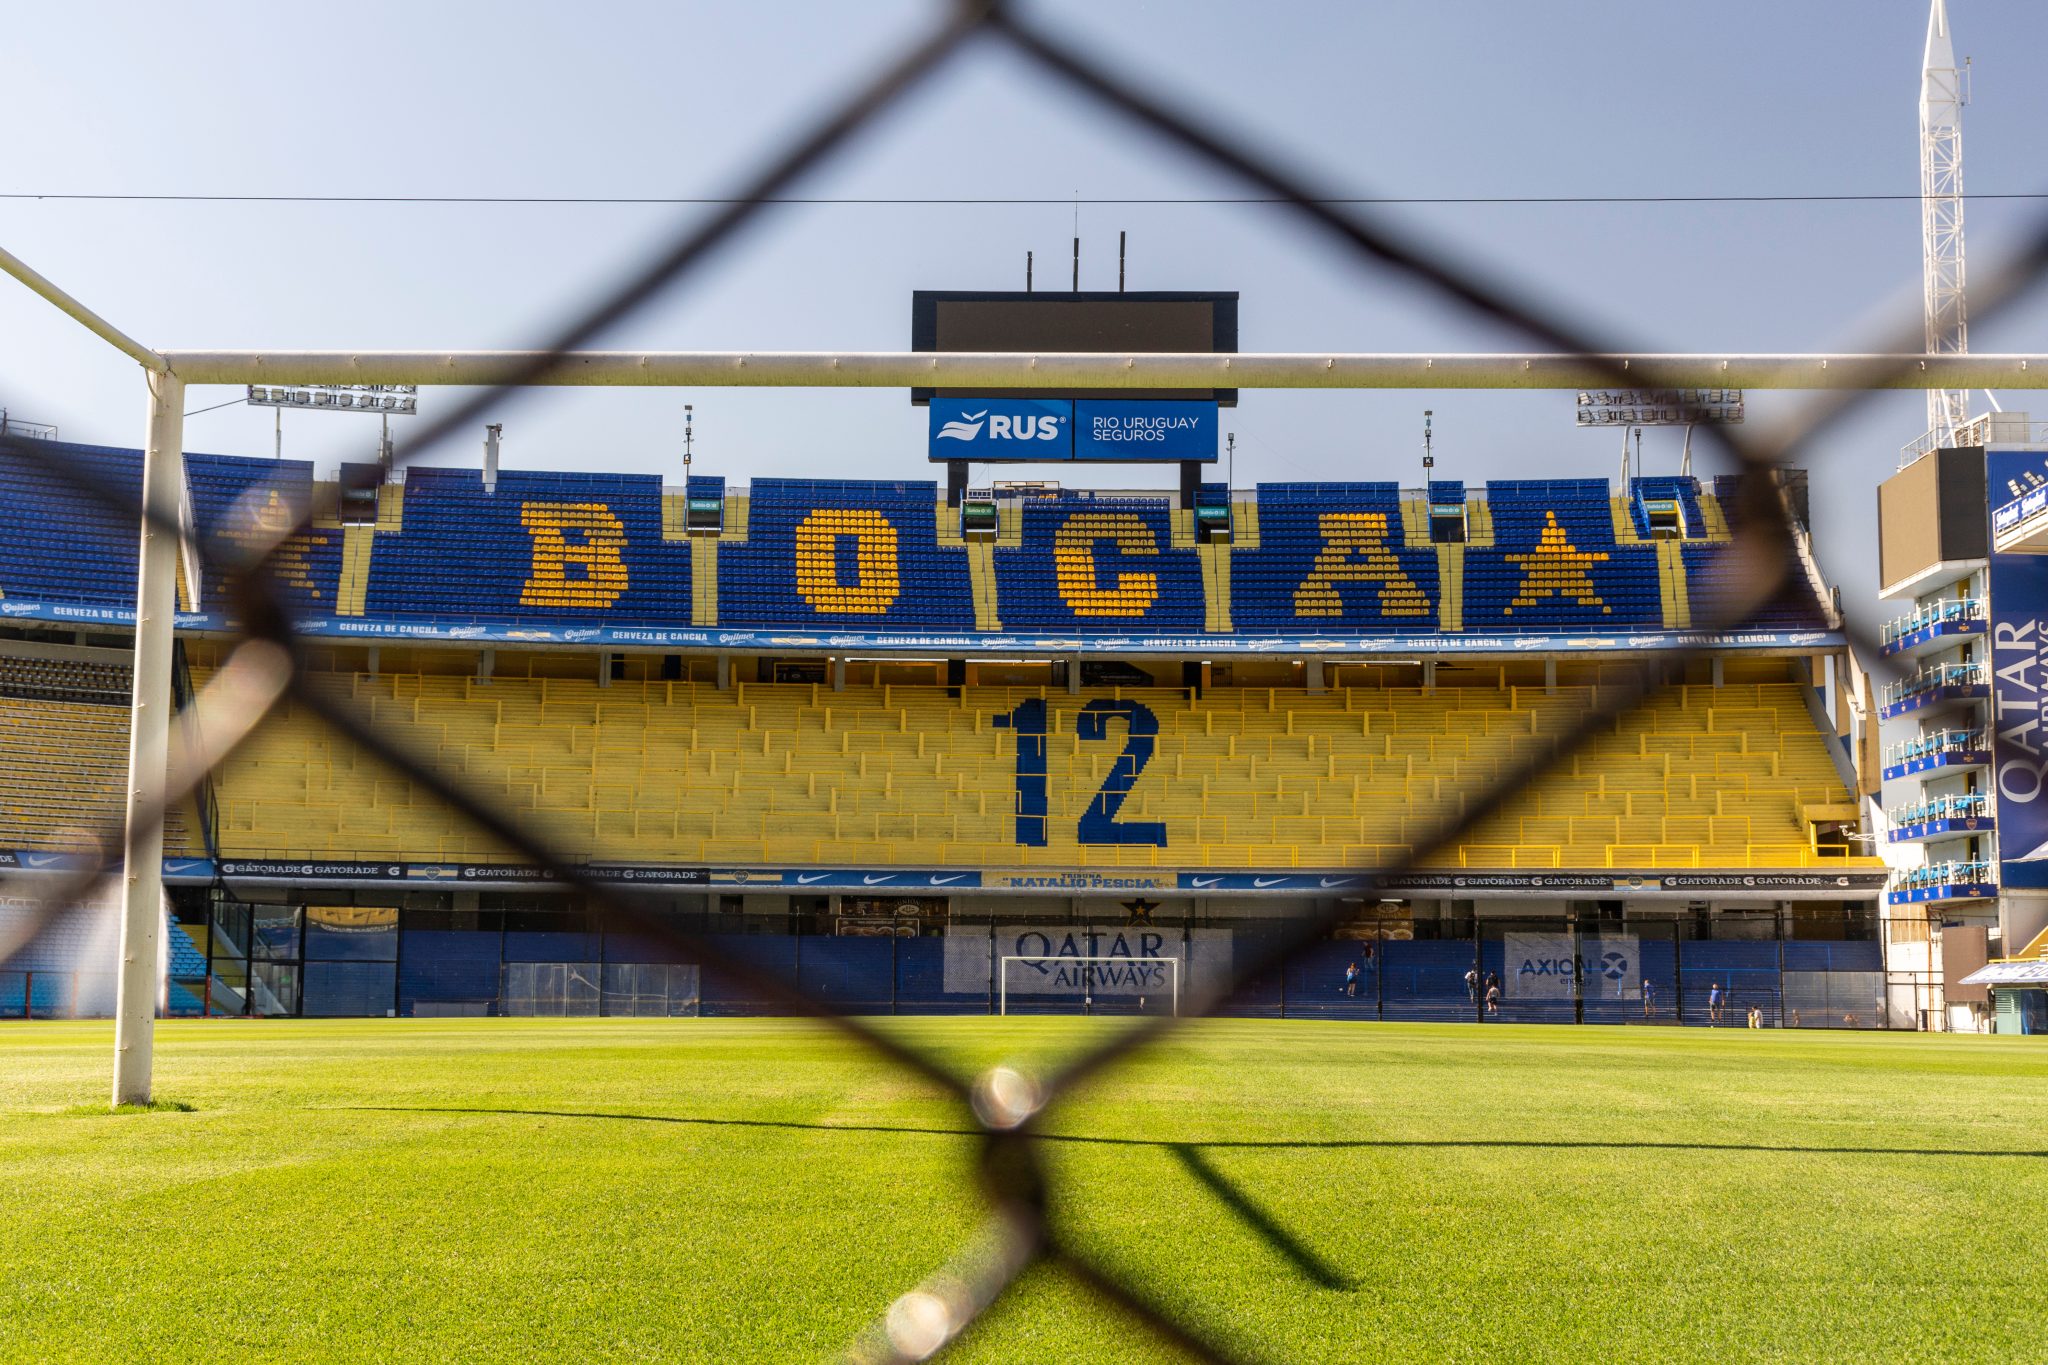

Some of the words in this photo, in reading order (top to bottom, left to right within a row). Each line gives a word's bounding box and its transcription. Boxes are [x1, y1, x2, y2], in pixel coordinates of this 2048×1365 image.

[1093, 416, 1119, 429] RIO
[1124, 416, 1200, 429] URUGUAY
[1093, 429, 1166, 441] SEGUROS
[53, 606, 99, 618] CERVEZA
[101, 608, 113, 619] DE
[339, 623, 381, 633] CERVEZA
[384, 625, 397, 633] DE
[399, 625, 438, 634] CANCHA
[612, 631, 654, 640] CERVEZA
[656, 631, 668, 640] DE
[670, 632, 708, 641] CANCHA
[876, 636, 918, 645] CERVEZA
[919, 637, 932, 645] DE
[934, 636, 971, 645] CANCHA
[1722, 634, 1735, 643] DE
[1738, 634, 1777, 643] CANCHA
[1143, 639, 1184, 647] CERVEZA
[1185, 639, 1197, 647] DE
[1199, 639, 1237, 648] CANCHA
[1407, 639, 1448, 647] CERVEZA
[1449, 639, 1462, 647] DE
[1464, 638, 1503, 647] CANCHA
[1994, 618, 2041, 803] QATAR
[992, 698, 1167, 847] 12
[236, 863, 301, 874] GATORADE
[314, 866, 379, 875] GATORADE
[635, 871, 697, 879] GATORADE
[1467, 876, 1531, 885] GATORADE
[1544, 876, 1607, 885] GATORADE
[1678, 876, 1742, 885] GATORADE
[1756, 876, 1821, 885] GATORADE
[1014, 930, 1166, 975] QATAR
[1519, 958, 1593, 976] AXION
[1054, 965, 1166, 988] AIRWAYS
